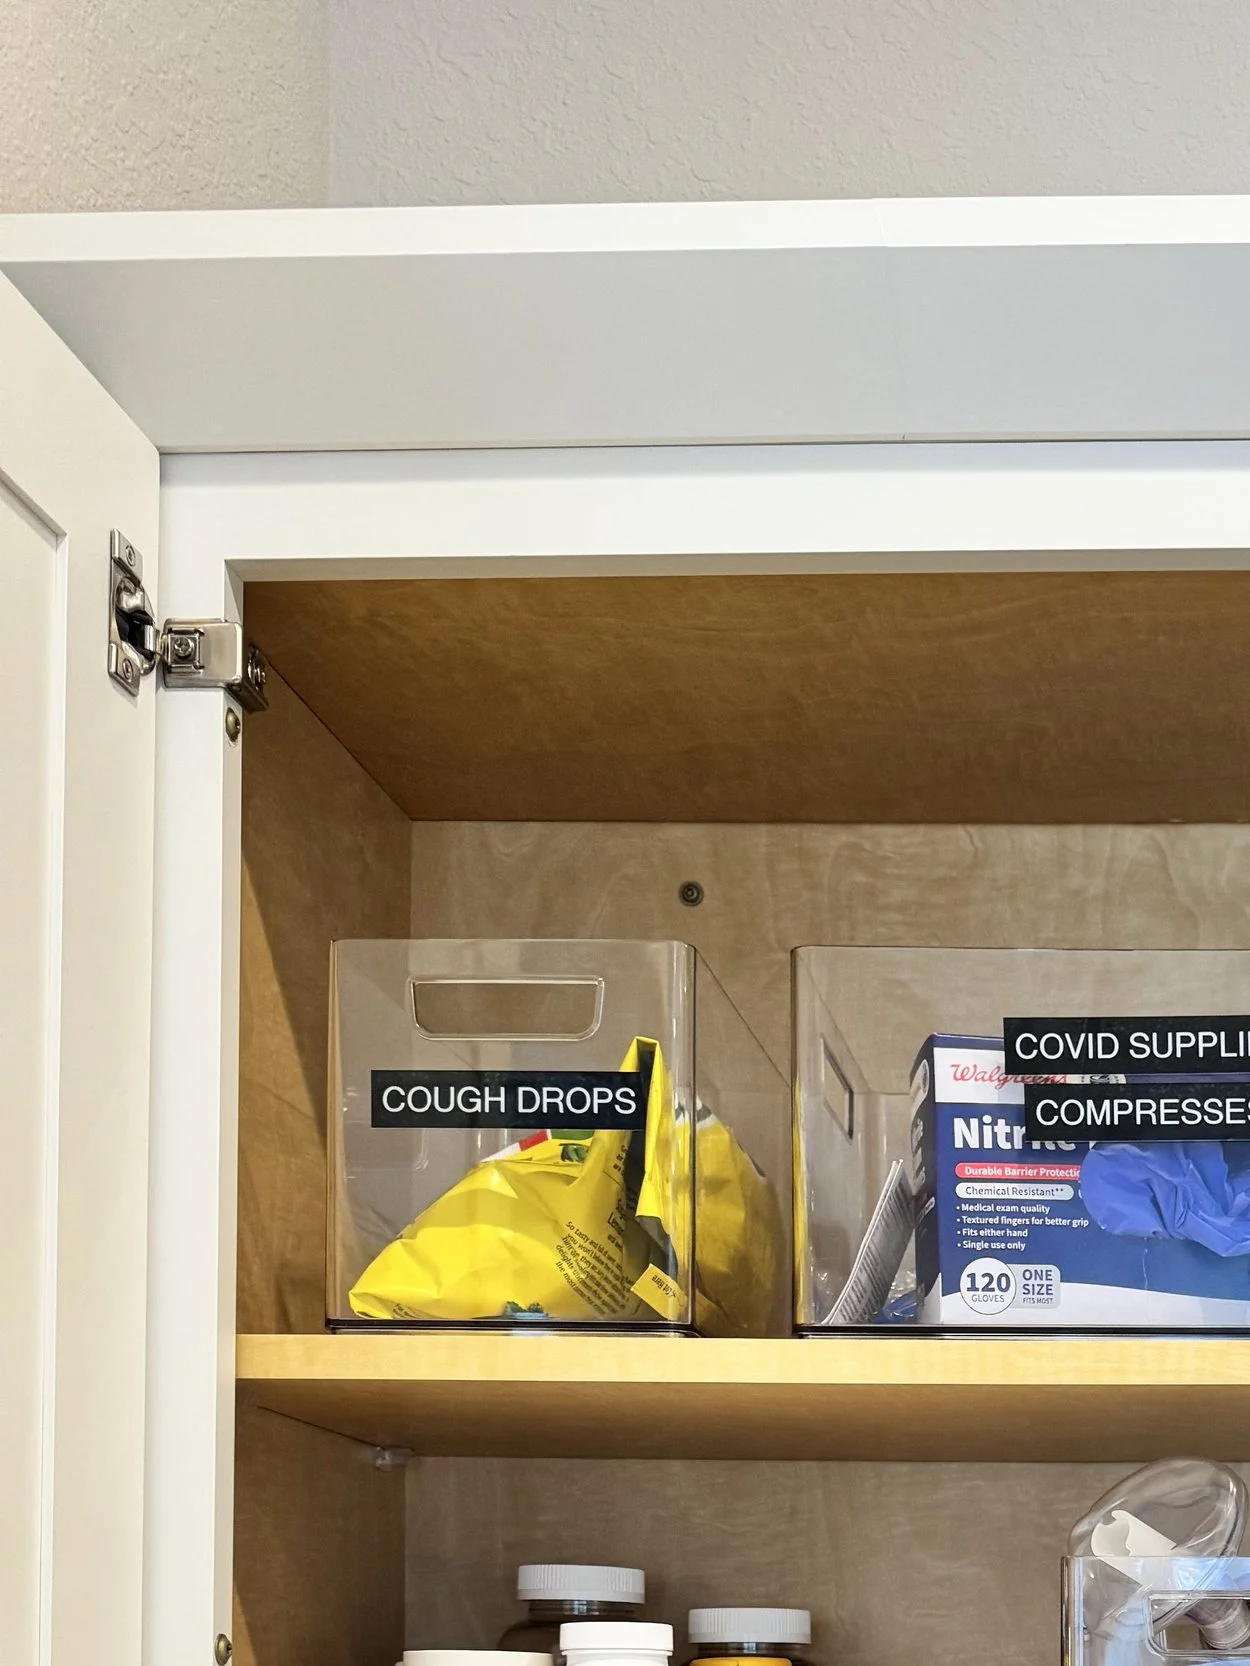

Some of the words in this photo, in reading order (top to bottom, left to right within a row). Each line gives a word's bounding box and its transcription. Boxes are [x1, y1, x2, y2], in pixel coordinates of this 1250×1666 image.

[1015, 1032, 1119, 1060] COVID
[382, 1086, 506, 1114] COUGH
[517, 1085, 637, 1115] DROPS
[964, 1166, 1003, 1176] Durable
[1004, 1167, 1037, 1177] Barrier
[965, 1186, 1010, 1197] Chemical
[962, 1204, 995, 1212] Medical
[995, 1205, 1019, 1213] exam
[1020, 1204, 1051, 1215] quality
[962, 1216, 1000, 1225] Textured
[1000, 1216, 1030, 1227] fingers
[1031, 1216, 1045, 1226] for
[1045, 1217, 1071, 1226] better
[1072, 1218, 1089, 1228] grip
[962, 1228, 979, 1237] Fits
[979, 1228, 1005, 1237] either
[1006, 1228, 1028, 1237] hand
[963, 1240, 989, 1251] Single
[991, 1241, 1006, 1249] use
[1007, 1240, 1026, 1251] only
[1022, 1269, 1053, 1281] ONE
[966, 1272, 1011, 1293] 120
[1022, 1283, 1053, 1296] SIZE
[971, 1294, 1005, 1303] GLOVES
